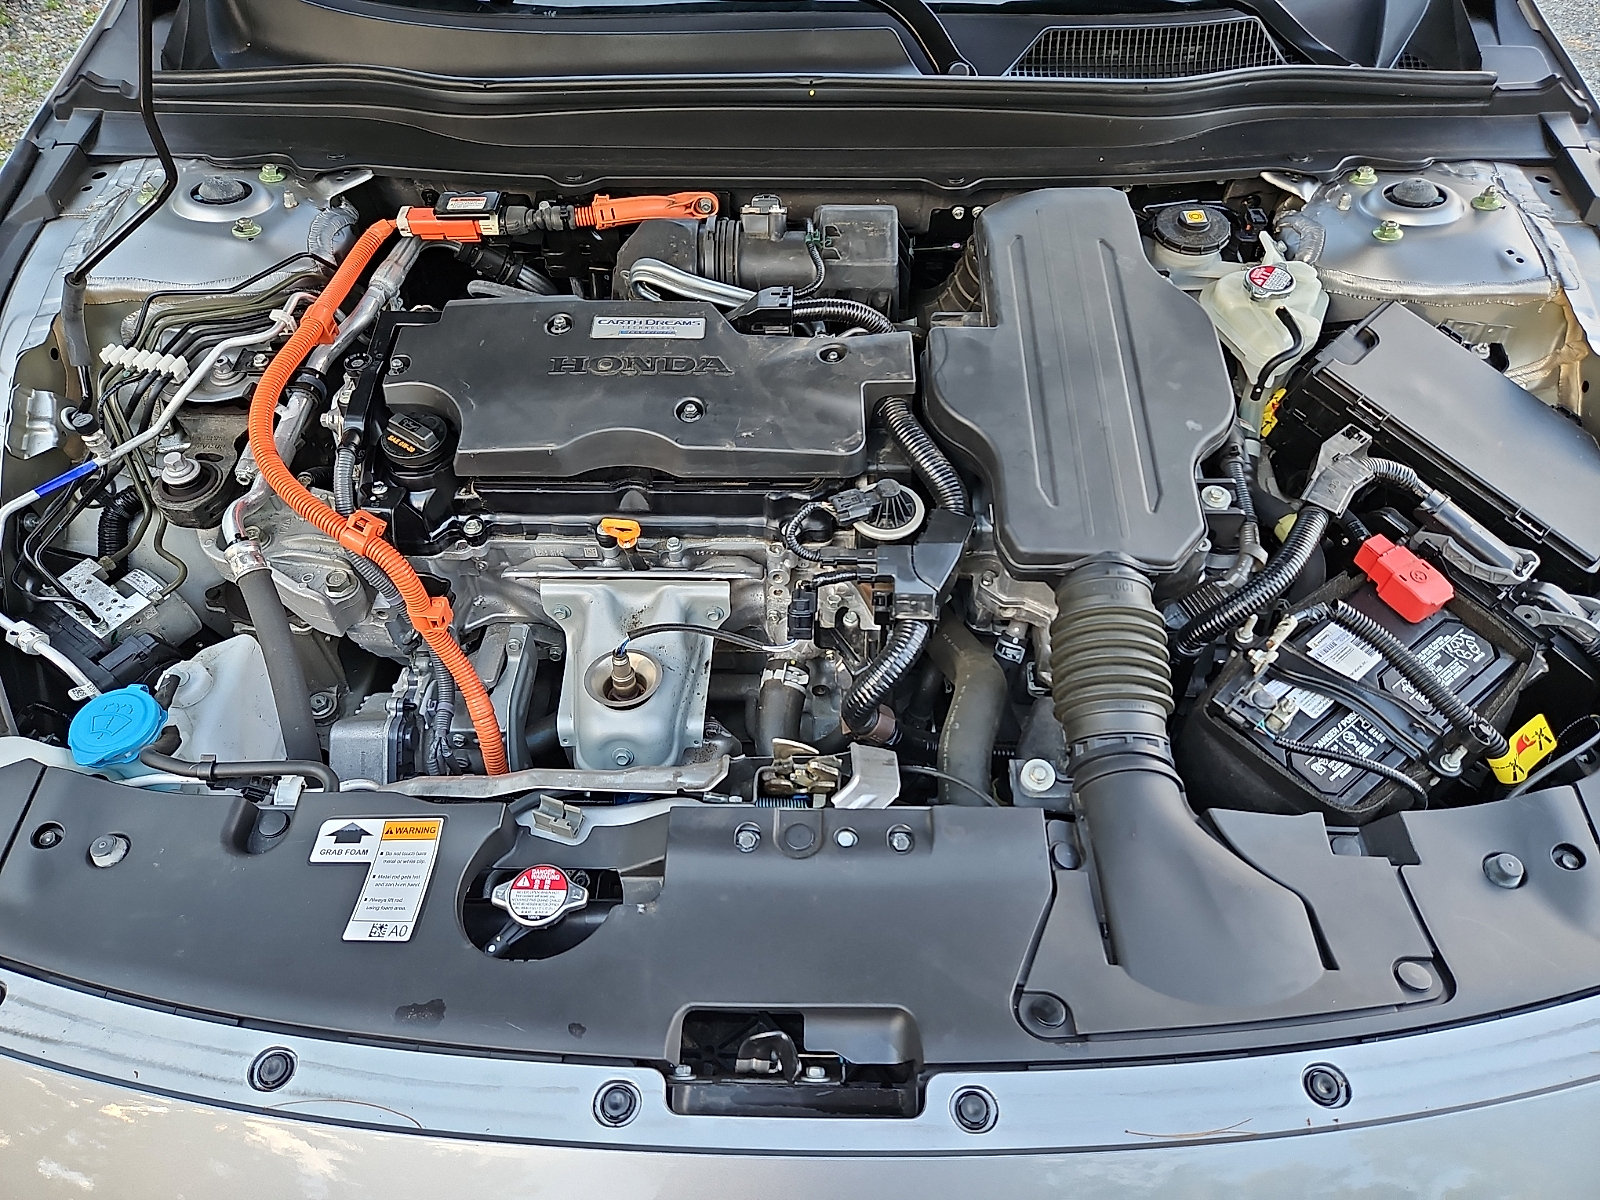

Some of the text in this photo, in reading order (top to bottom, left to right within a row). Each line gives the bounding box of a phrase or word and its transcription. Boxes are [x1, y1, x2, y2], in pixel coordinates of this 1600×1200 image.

[548, 355, 735, 377] HONDA
[387, 434, 416, 453] SAE 0W-20
[395, 826, 436, 835] WARNING
[319, 848, 369, 856] GRAB FOAM
[387, 924, 408, 938] A0
